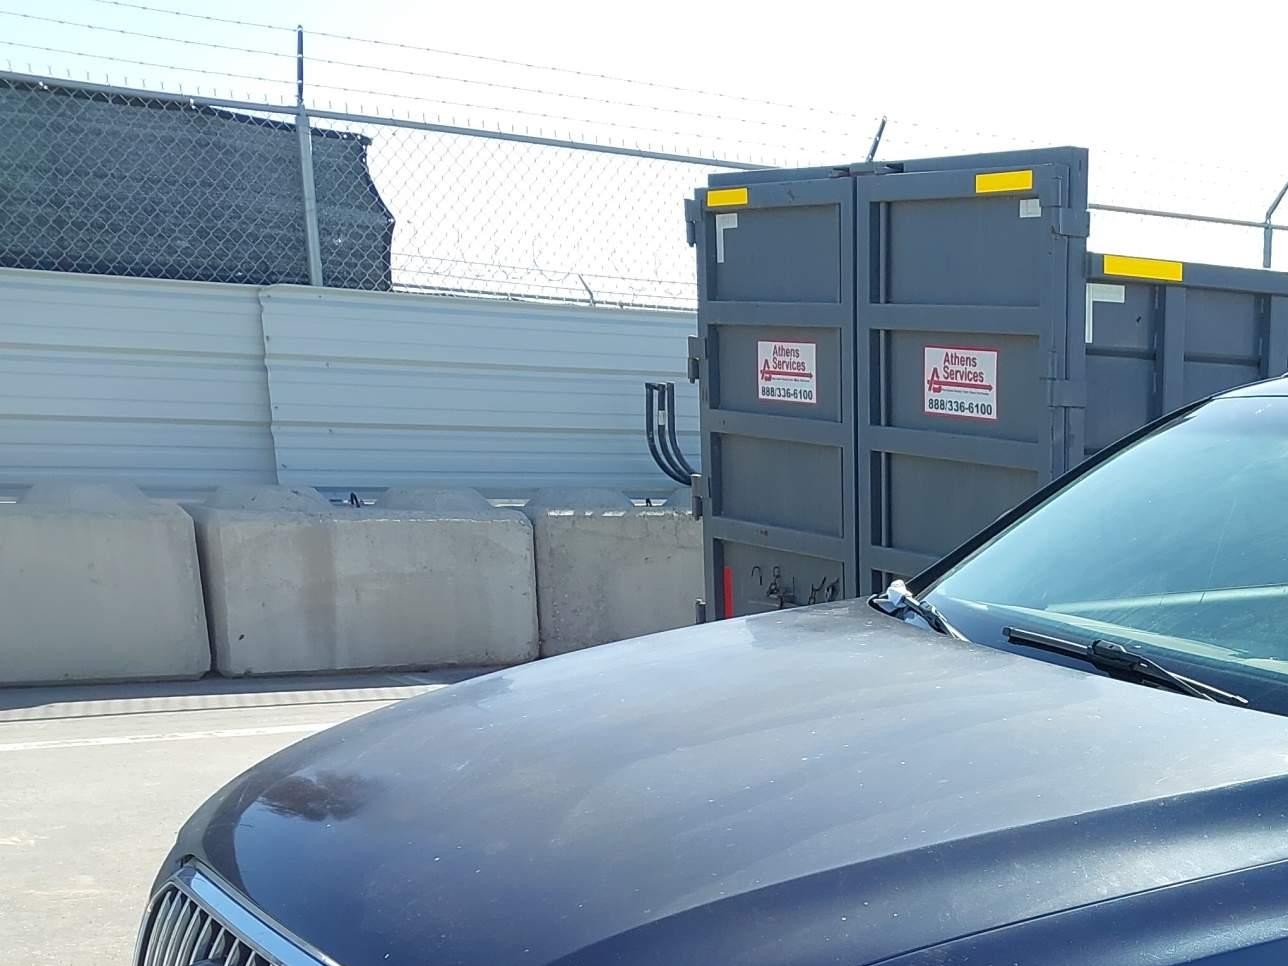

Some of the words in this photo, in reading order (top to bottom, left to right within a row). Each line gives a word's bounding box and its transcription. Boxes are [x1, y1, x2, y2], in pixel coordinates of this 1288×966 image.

[772, 344, 800, 358] Athens
[772, 357, 806, 372] Services
[943, 351, 977, 368] Athens
[942, 366, 985, 383] Services
[761, 386, 813, 401] 888/336-6100
[928, 398, 993, 415] 888/336-6100
